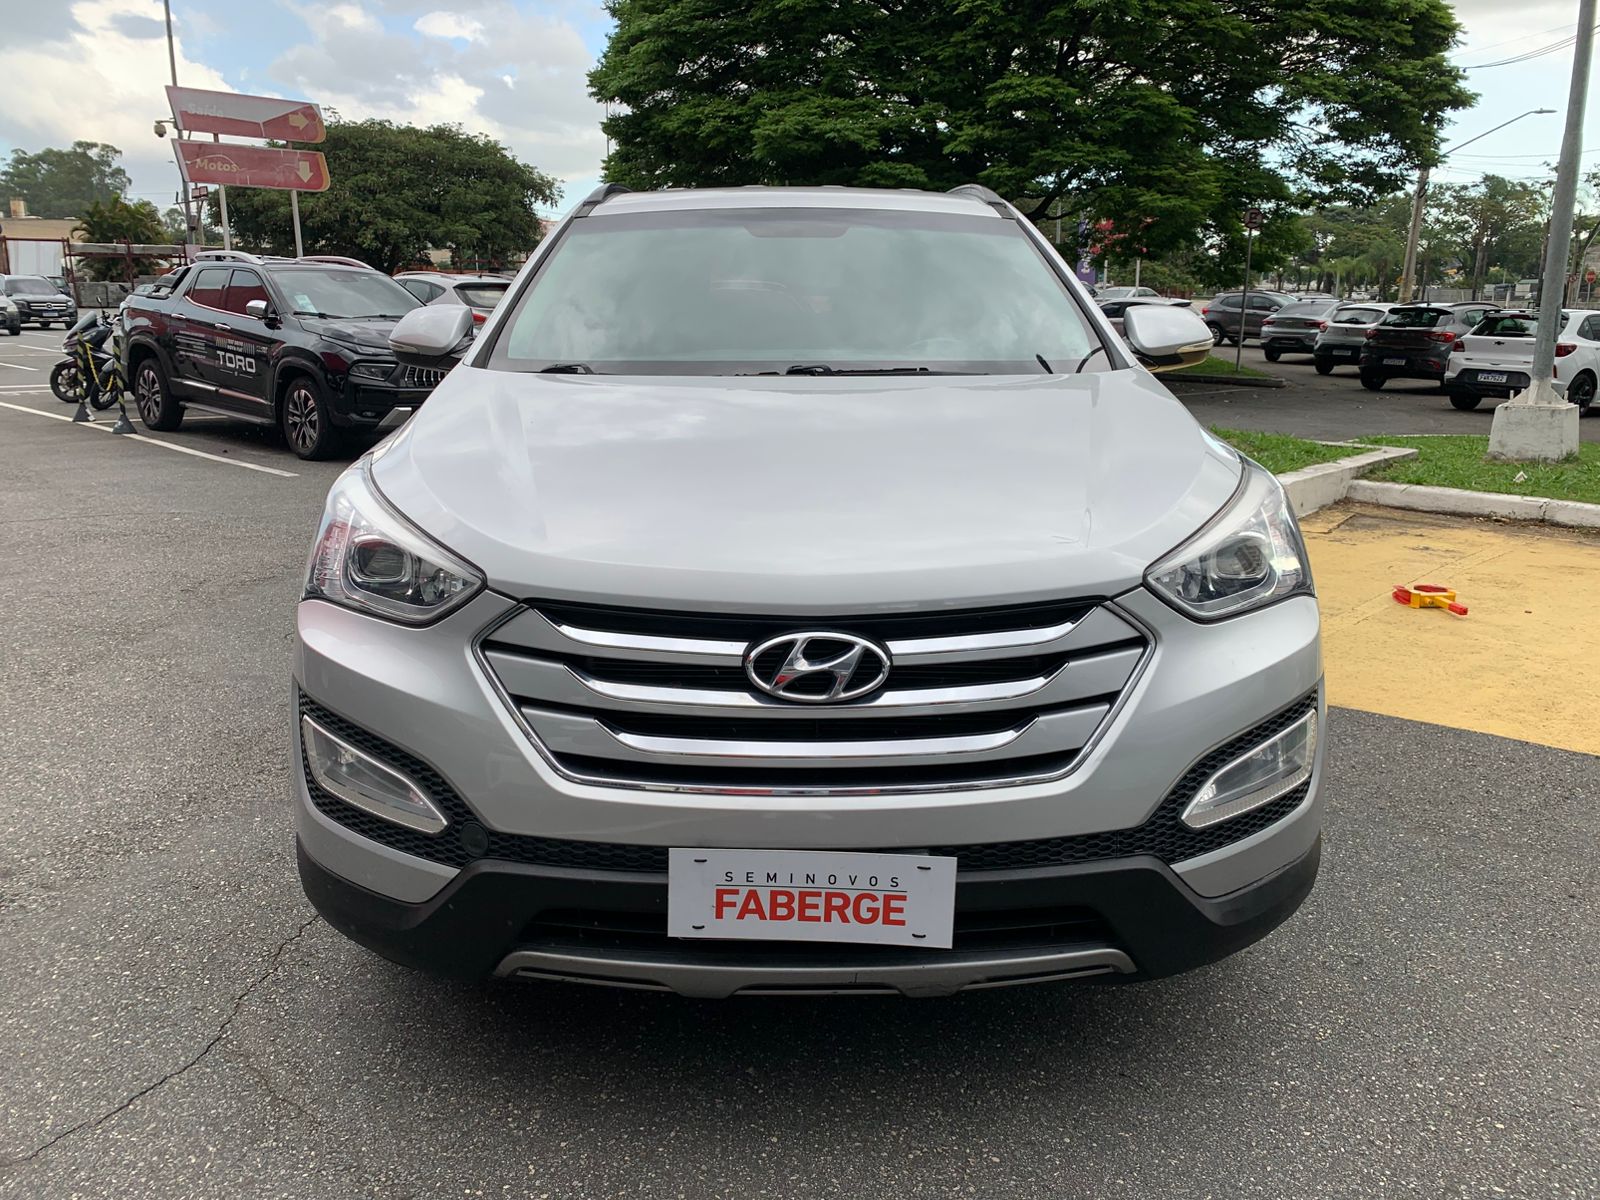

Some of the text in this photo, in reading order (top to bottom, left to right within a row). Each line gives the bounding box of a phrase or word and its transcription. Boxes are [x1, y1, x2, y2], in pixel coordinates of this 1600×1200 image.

[195, 158, 238, 173] Motos
[216, 350, 256, 373] TORO
[724, 871, 900, 888] SEMINOVOS
[714, 888, 908, 927] FABERGE
